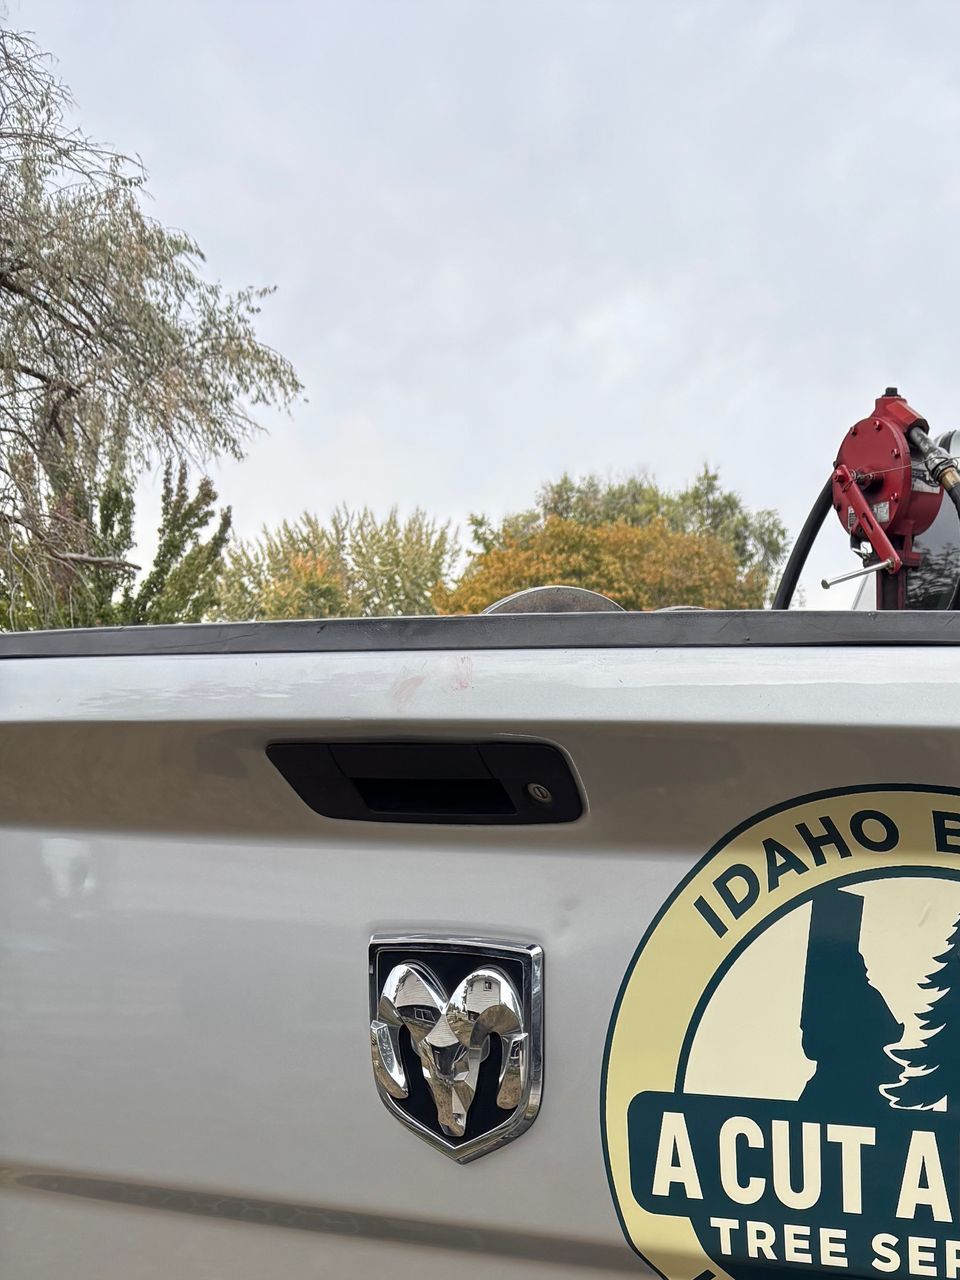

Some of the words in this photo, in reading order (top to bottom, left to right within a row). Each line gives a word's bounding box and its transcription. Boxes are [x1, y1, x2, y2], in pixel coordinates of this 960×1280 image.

[693, 809, 900, 939] IDAHO
[652, 1111, 704, 1200] A
[718, 1116, 877, 1214] CUT
[709, 1216, 849, 1268] TREE
